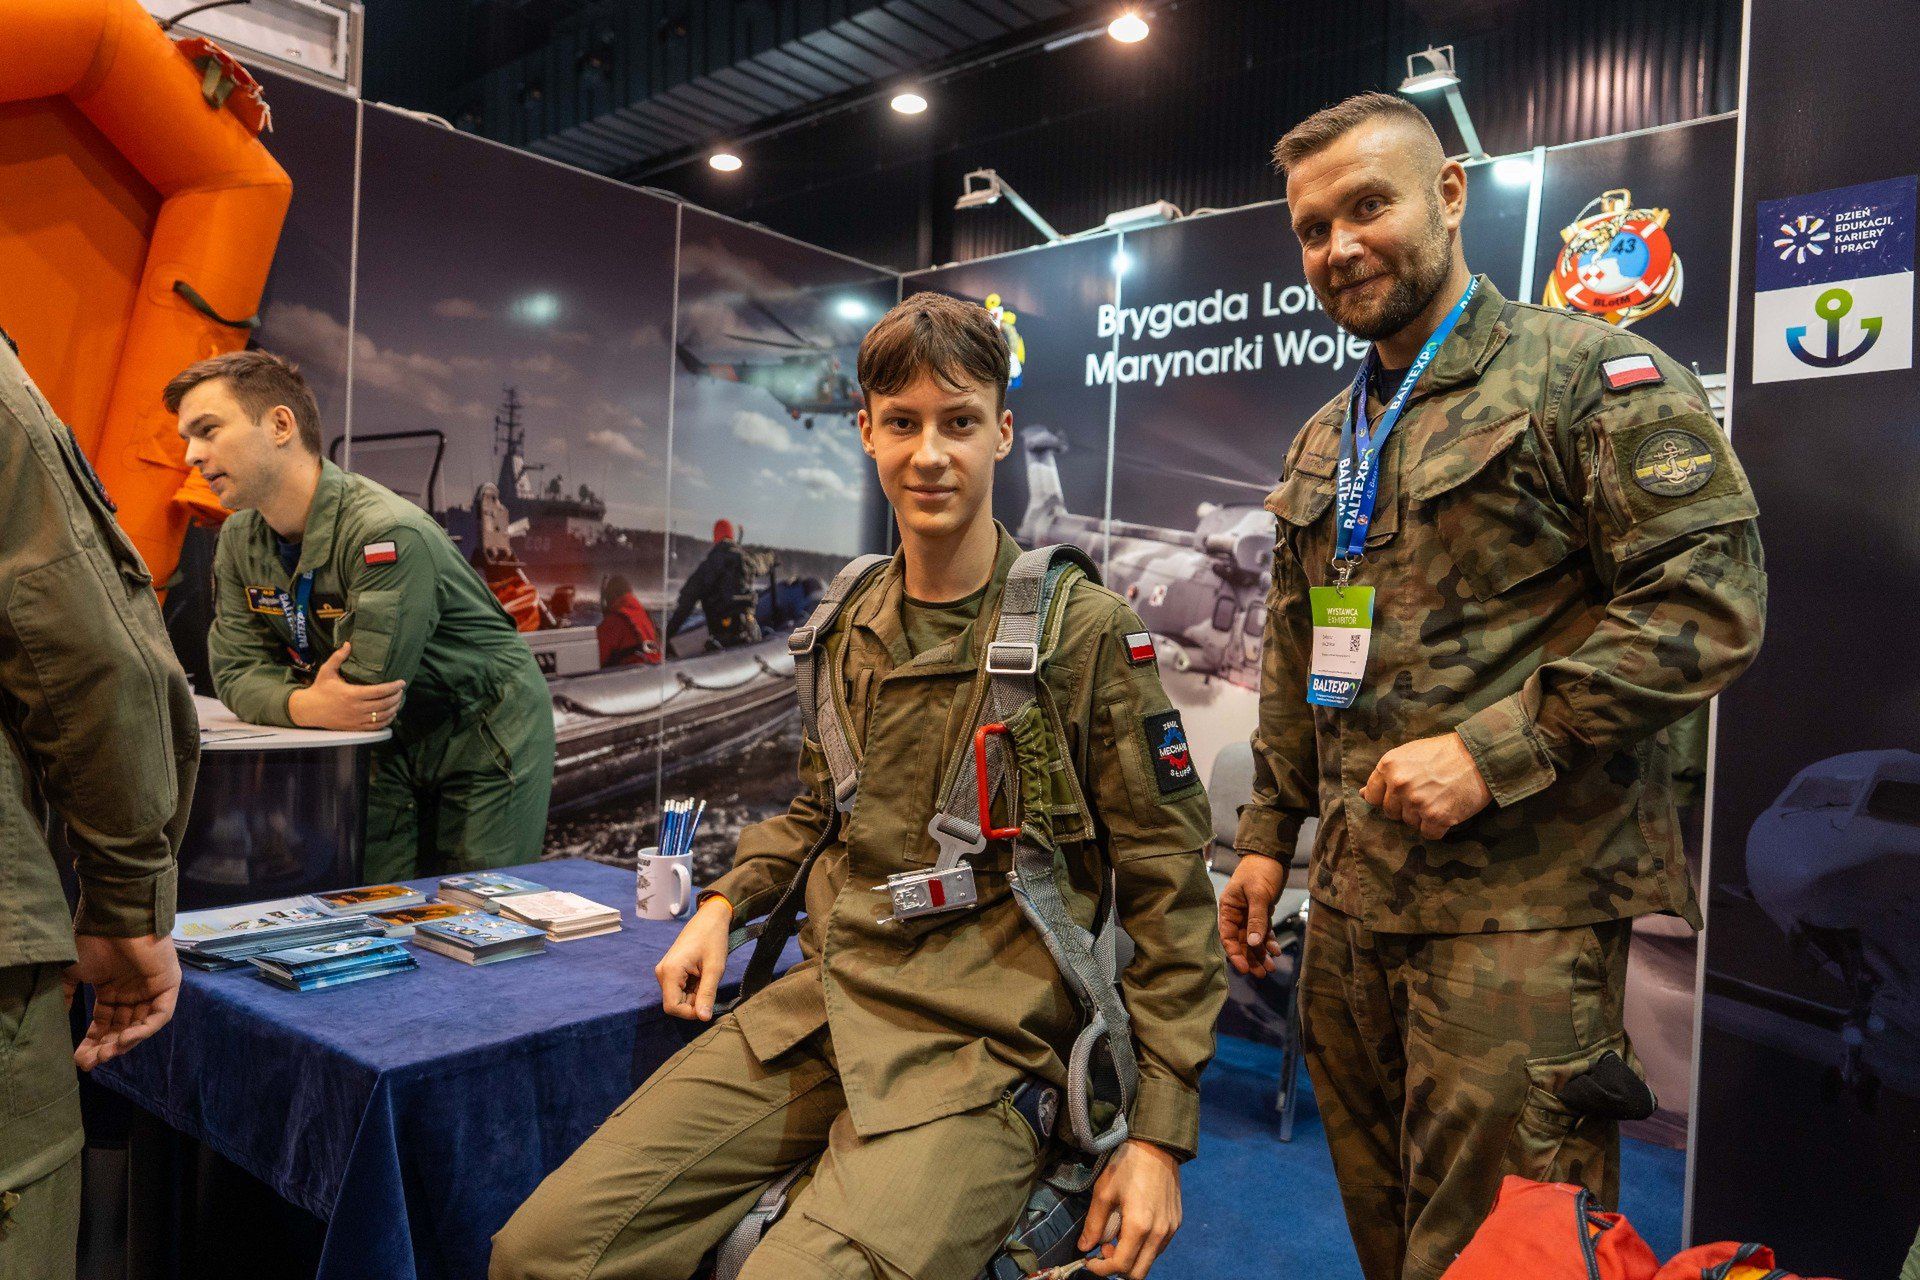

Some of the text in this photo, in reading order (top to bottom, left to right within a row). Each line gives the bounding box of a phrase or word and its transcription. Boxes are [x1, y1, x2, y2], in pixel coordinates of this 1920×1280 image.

[1835, 206, 1871, 222] DZIEŃ
[1835, 216, 1894, 233] EDUKACJI,
[1835, 228, 1885, 244] KARIERY
[1612, 238, 1637, 254] 43
[1834, 240, 1879, 254] I PRACY
[1097, 281, 1324, 340] Brygada Lot
[1085, 333, 1264, 387] Marynarki
[1326, 608, 1358, 616] WYSTAWCA
[1328, 616, 1357, 625] EXHIBITOR
